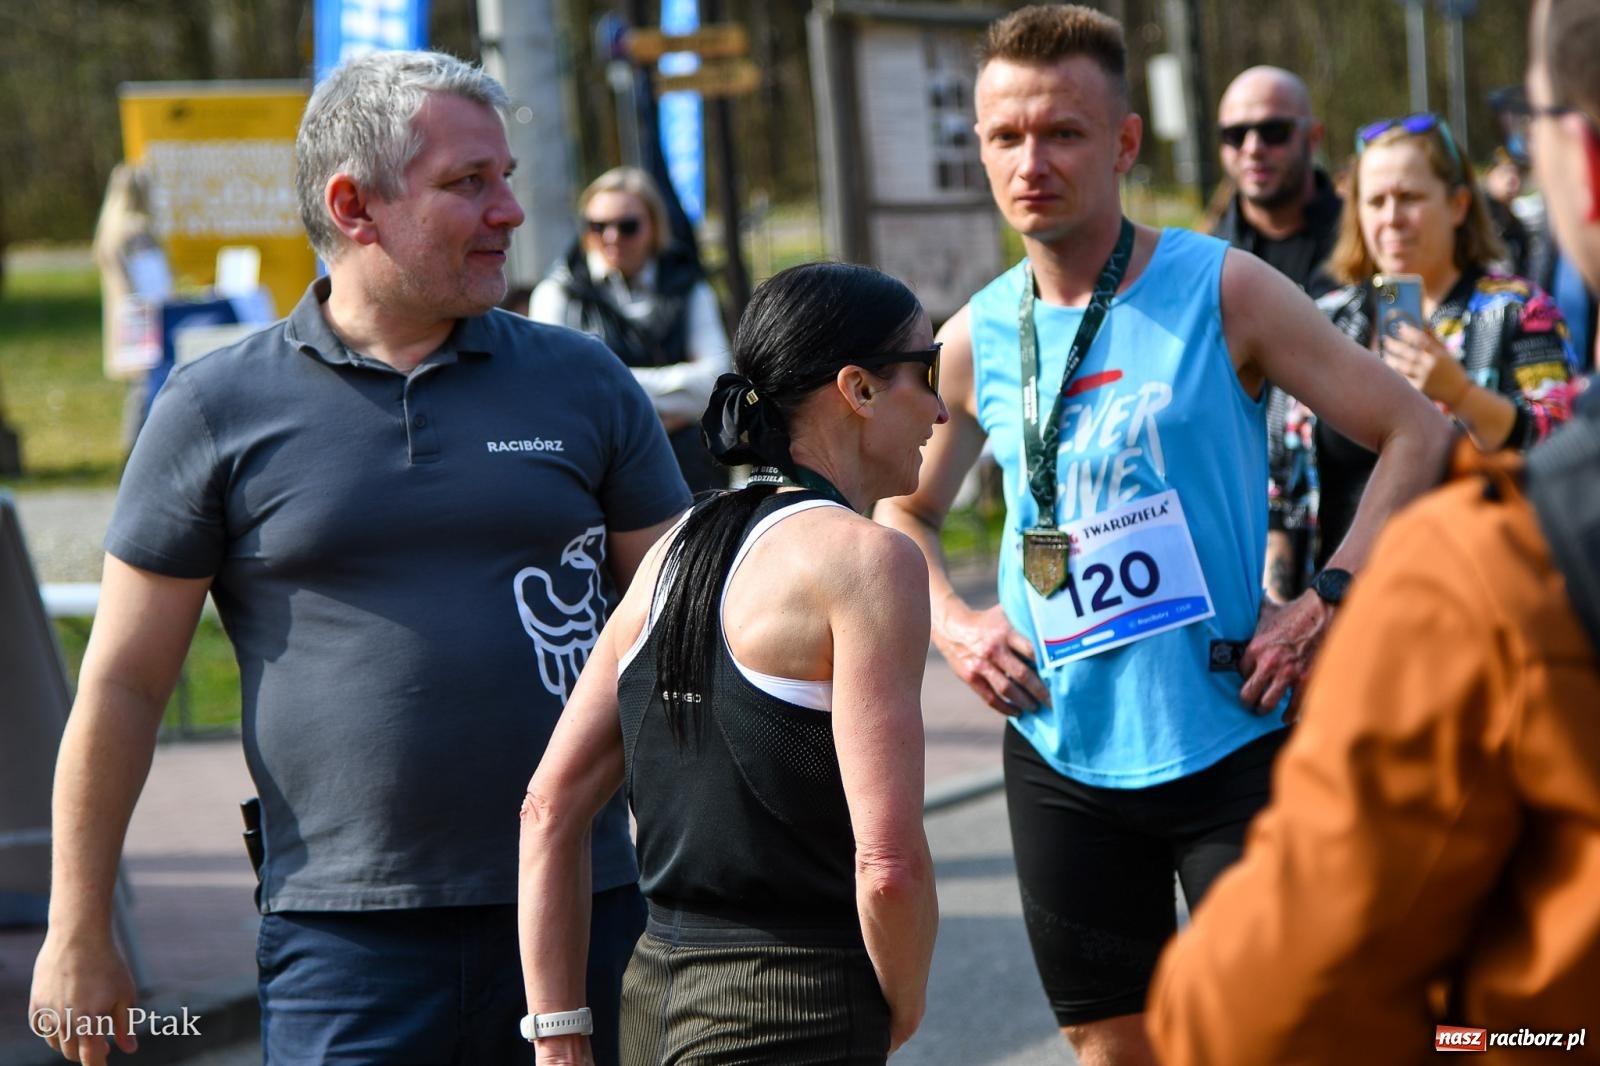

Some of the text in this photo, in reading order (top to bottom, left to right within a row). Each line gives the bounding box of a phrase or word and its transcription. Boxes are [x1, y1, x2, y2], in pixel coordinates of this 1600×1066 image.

[487, 437, 565, 453] RACIBÓRZ
[1057, 447, 1142, 520] IVE
[1059, 550, 1160, 618] 120
